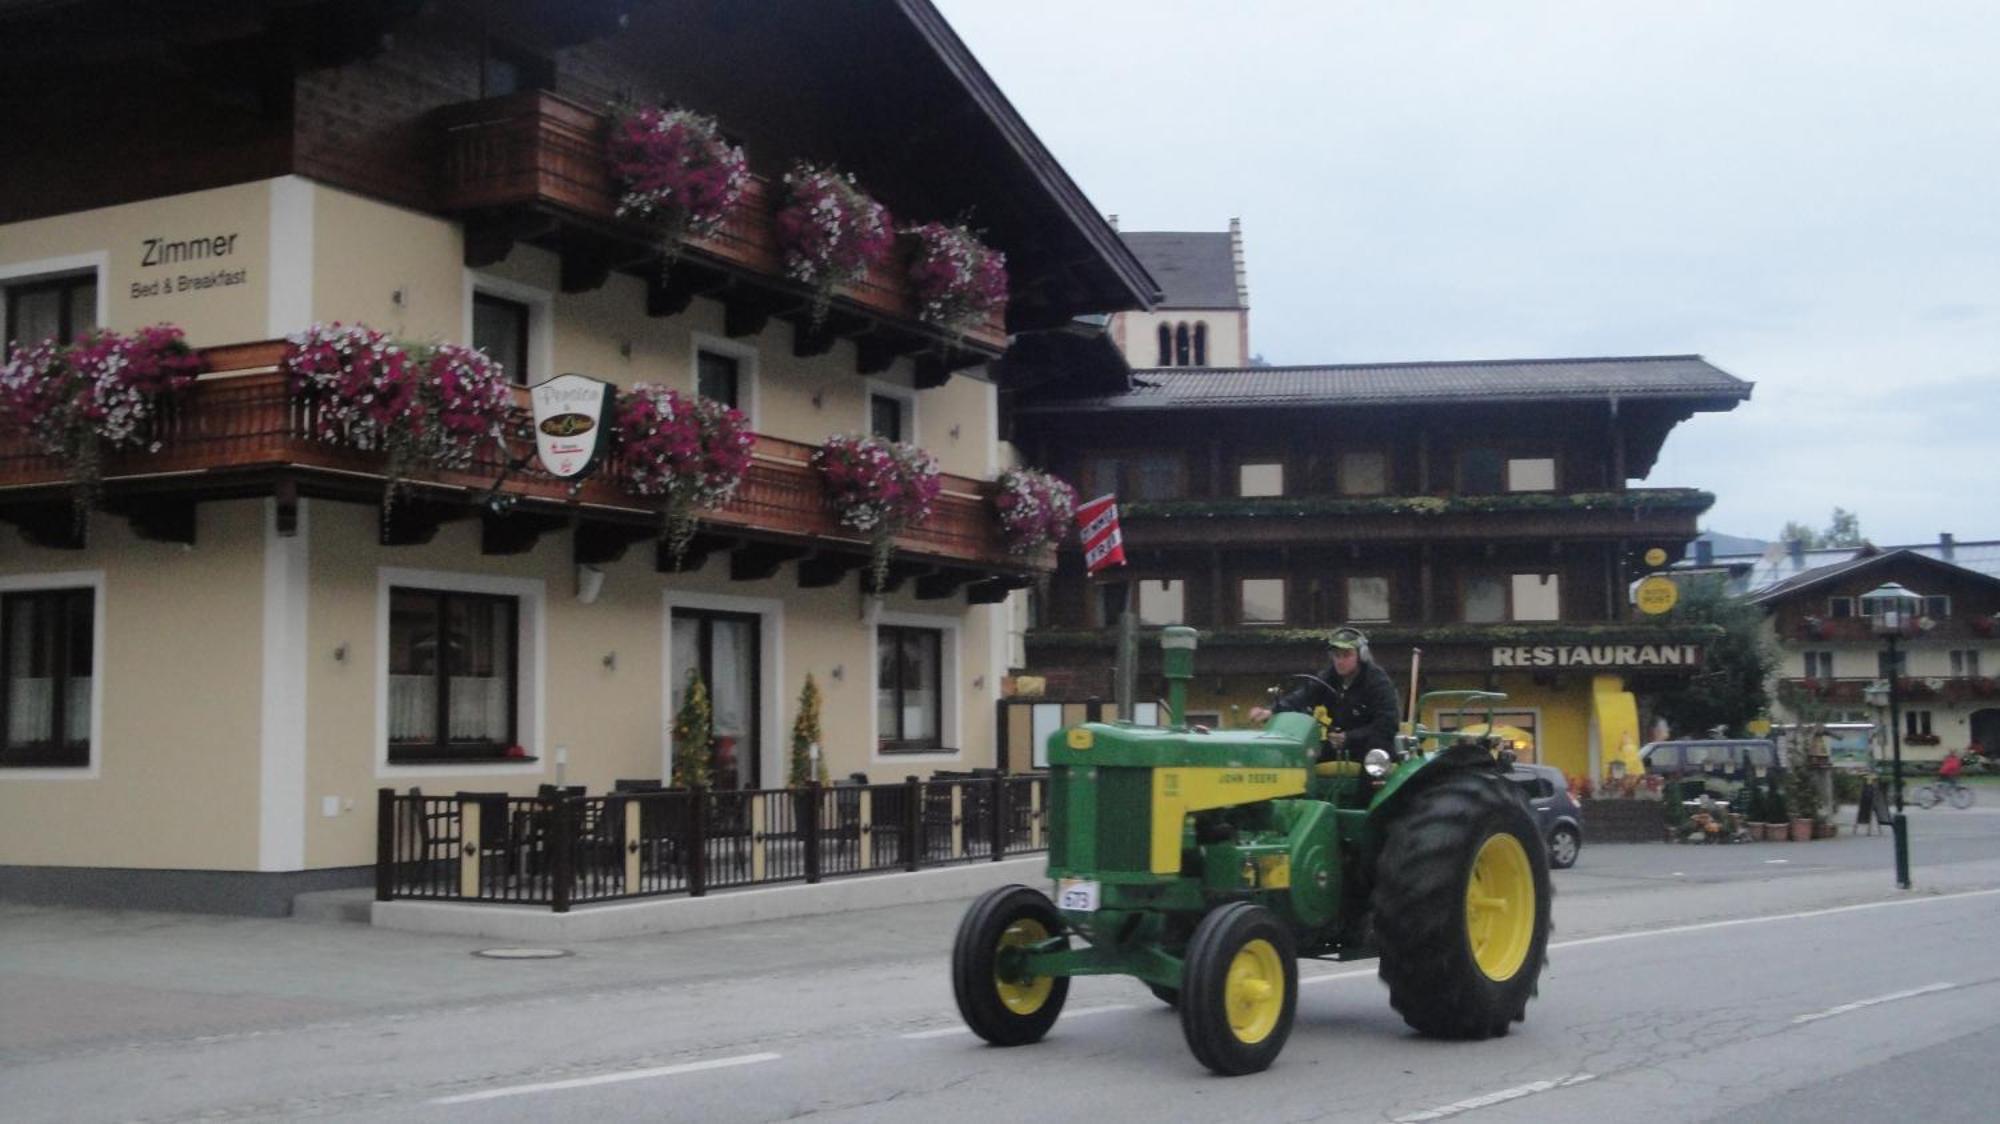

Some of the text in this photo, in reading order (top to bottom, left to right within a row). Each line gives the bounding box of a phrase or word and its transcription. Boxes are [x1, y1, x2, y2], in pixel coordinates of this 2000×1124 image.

[141, 232, 238, 267] Zimmer
[130, 269, 247, 299] Bed & Breakfast
[1492, 644, 1698, 667] RESTAURANT
[1218, 772, 1278, 785] JOHN DEERE
